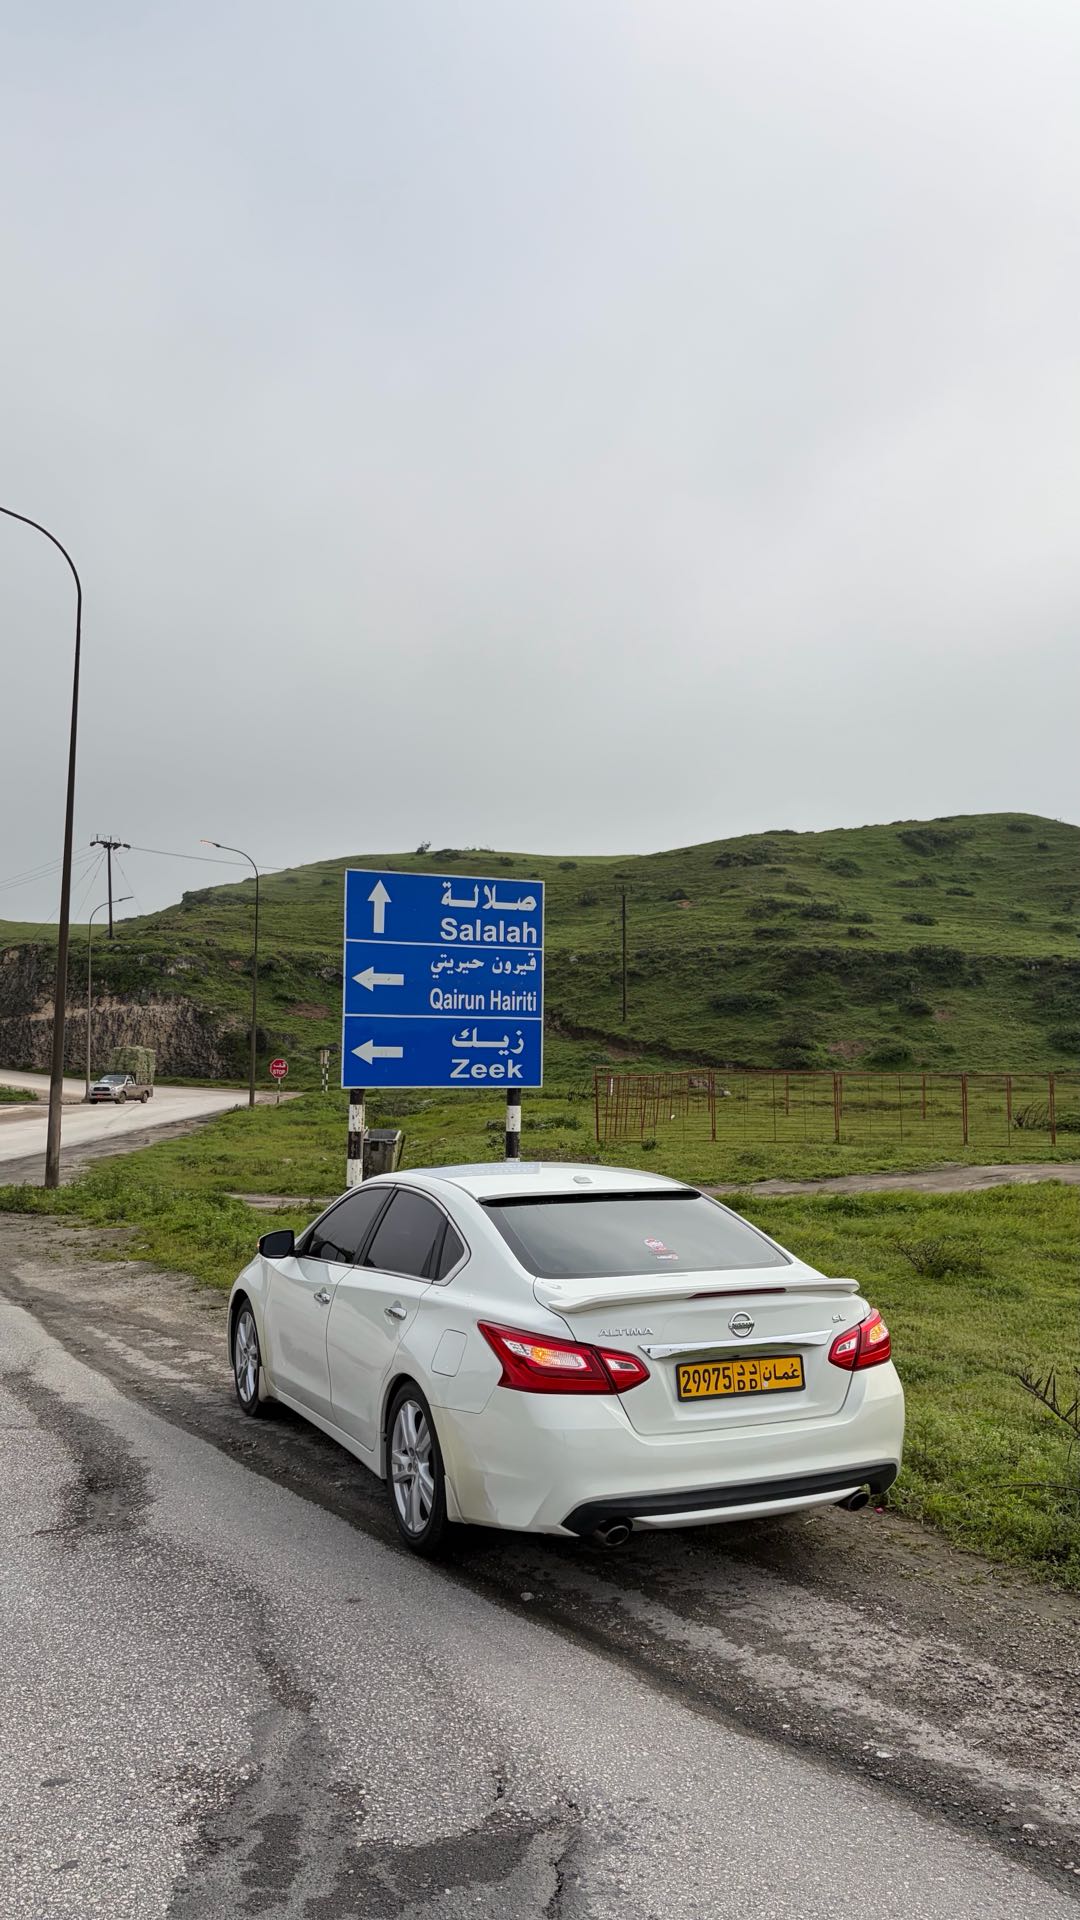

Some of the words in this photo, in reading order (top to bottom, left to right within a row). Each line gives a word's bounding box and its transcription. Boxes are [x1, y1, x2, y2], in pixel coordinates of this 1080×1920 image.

[441, 881, 537, 911] صلالة
[440, 918, 537, 944] Salalah
[430, 953, 485, 979] حيريتي
[491, 952, 537, 975] قيرون
[429, 987, 485, 1011] Qairun
[490, 990, 537, 1012] Hairiti
[451, 1027, 524, 1056] زيك
[449, 1058, 523, 1079] Zeek
[831, 1314, 846, 1324] SL
[598, 1327, 654, 1337] ALTIMA
[681, 1366, 732, 1393] 29975
